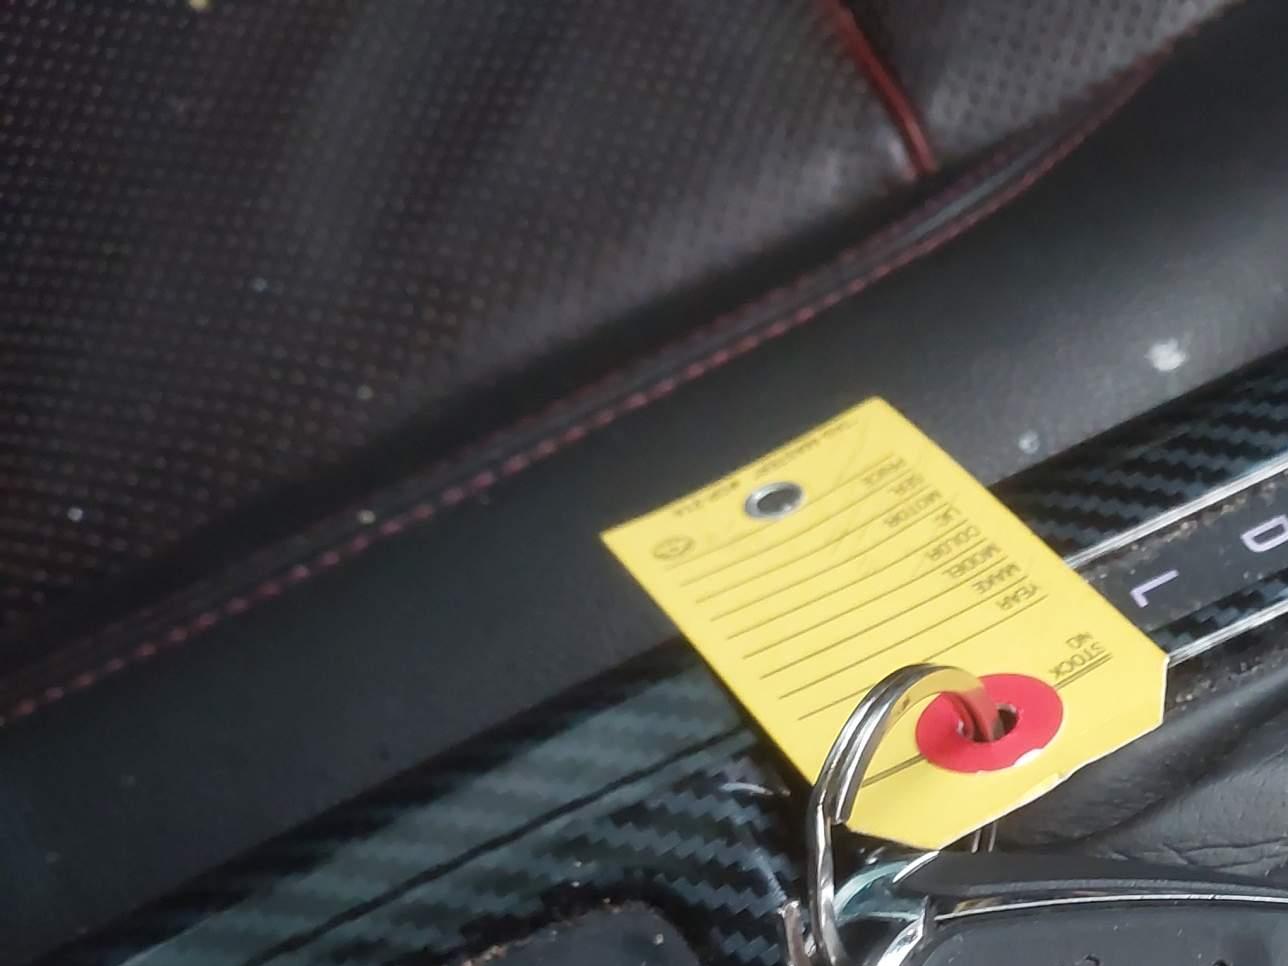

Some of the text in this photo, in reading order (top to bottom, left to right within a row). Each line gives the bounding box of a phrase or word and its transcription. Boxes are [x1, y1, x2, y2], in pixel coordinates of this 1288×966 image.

[883, 489, 942, 527] MOTOR
[926, 524, 981, 560] COLOR
[942, 543, 1002, 578] MODEL
[972, 563, 1021, 594] MAKE
[996, 584, 1040, 610] YEAR
[1130, 570, 1178, 607] L
[1048, 642, 1106, 680] STOCK
